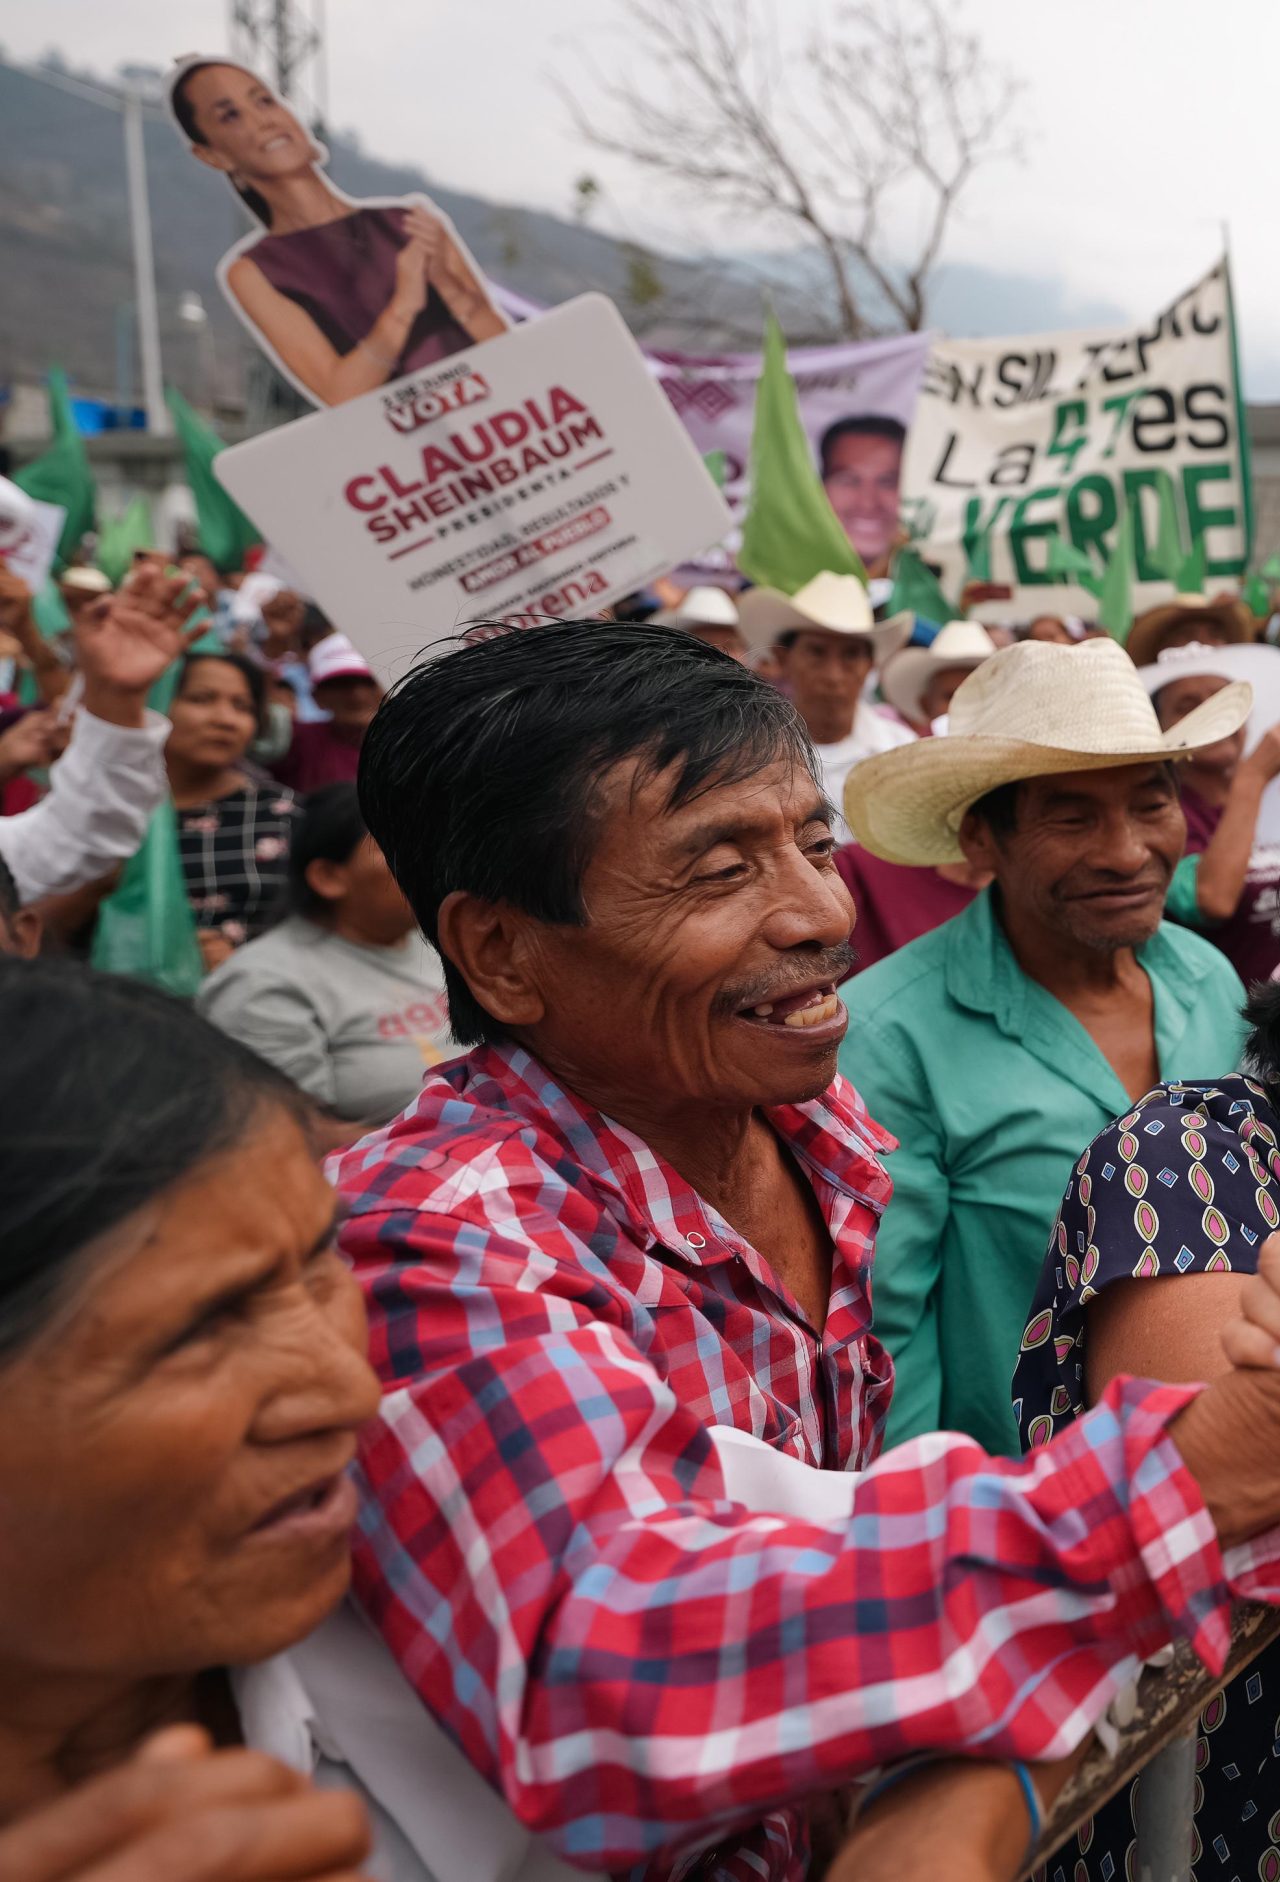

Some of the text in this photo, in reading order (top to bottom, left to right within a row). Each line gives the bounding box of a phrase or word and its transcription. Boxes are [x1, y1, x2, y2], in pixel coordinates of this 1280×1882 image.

[344, 384, 586, 513] CLAUDIA
[386, 375, 488, 430] VOTA
[932, 431, 1037, 489] La
[1131, 382, 1230, 453] es
[366, 415, 604, 544] SHEINBAUM
[436, 467, 571, 539] PRESIDENTA
